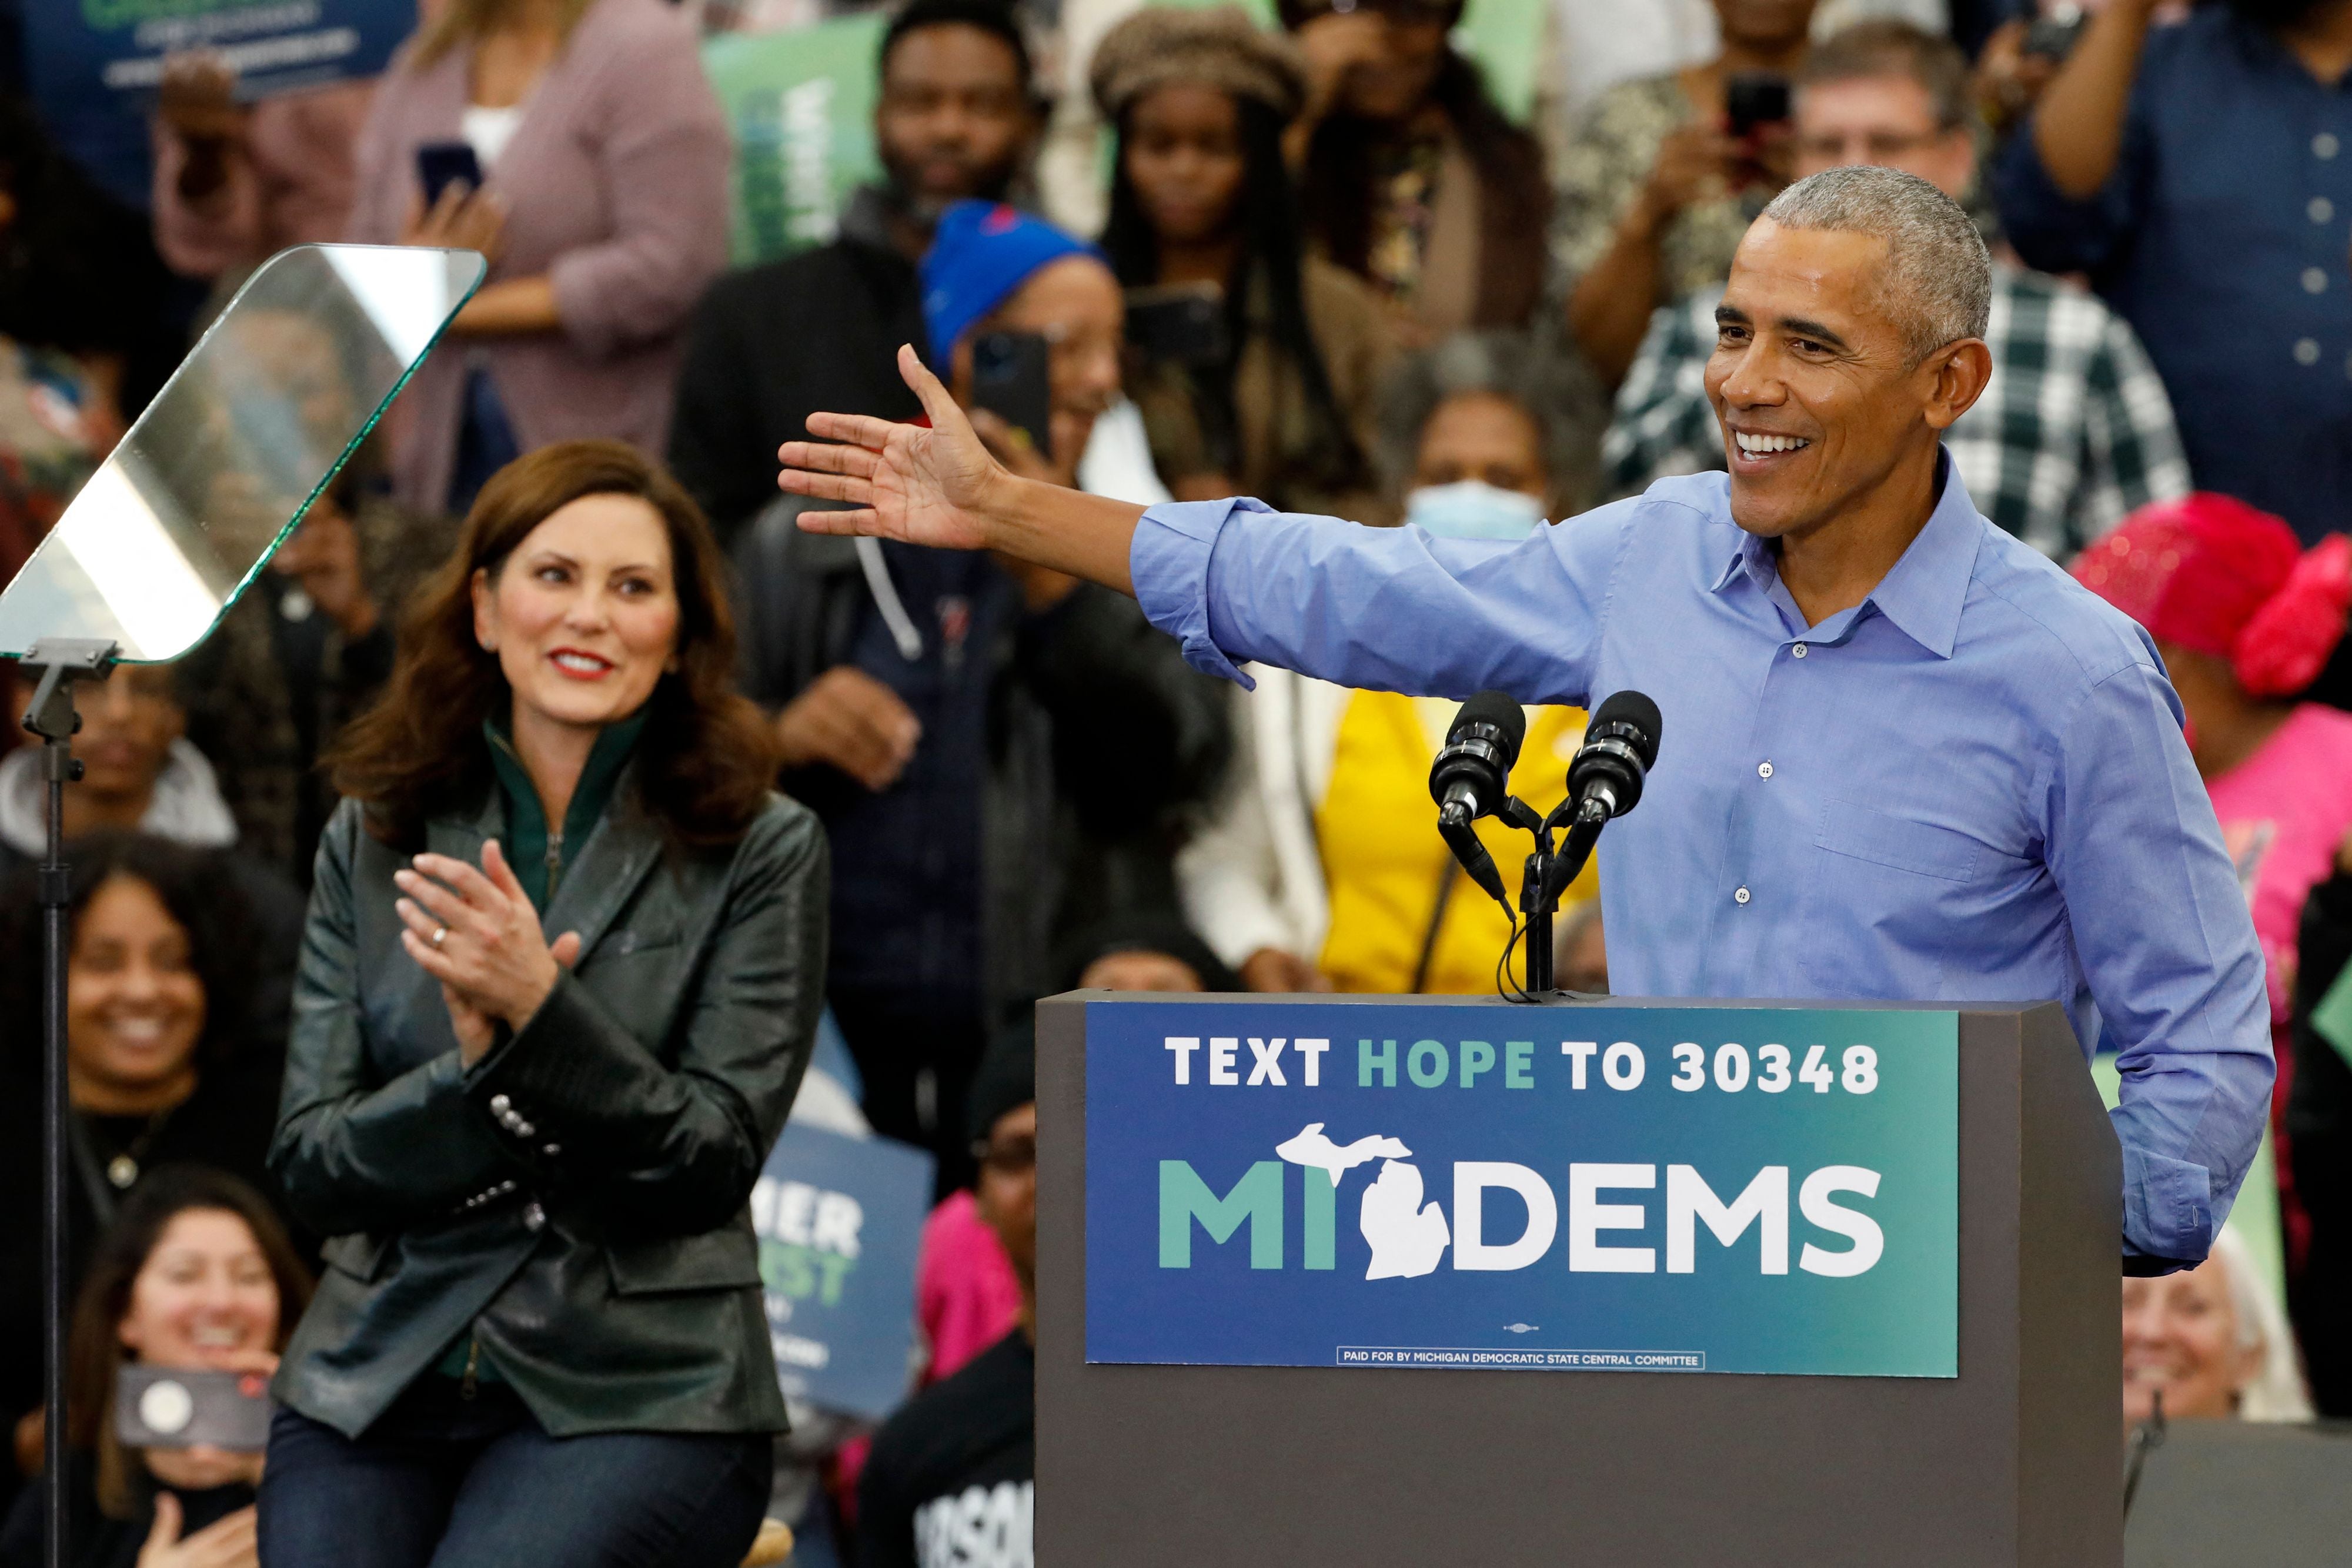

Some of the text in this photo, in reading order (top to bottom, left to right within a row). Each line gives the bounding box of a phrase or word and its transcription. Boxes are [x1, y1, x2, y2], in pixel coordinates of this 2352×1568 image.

[1164, 1037, 1879, 1095] TEXT HOPE TO 30348
[1454, 1161, 1884, 1278] DEMS
[1344, 1351, 1699, 1366] PAID FOR BY MICHIGAN DEMOCRATIC STATE CENTRAL COMMITTEE
